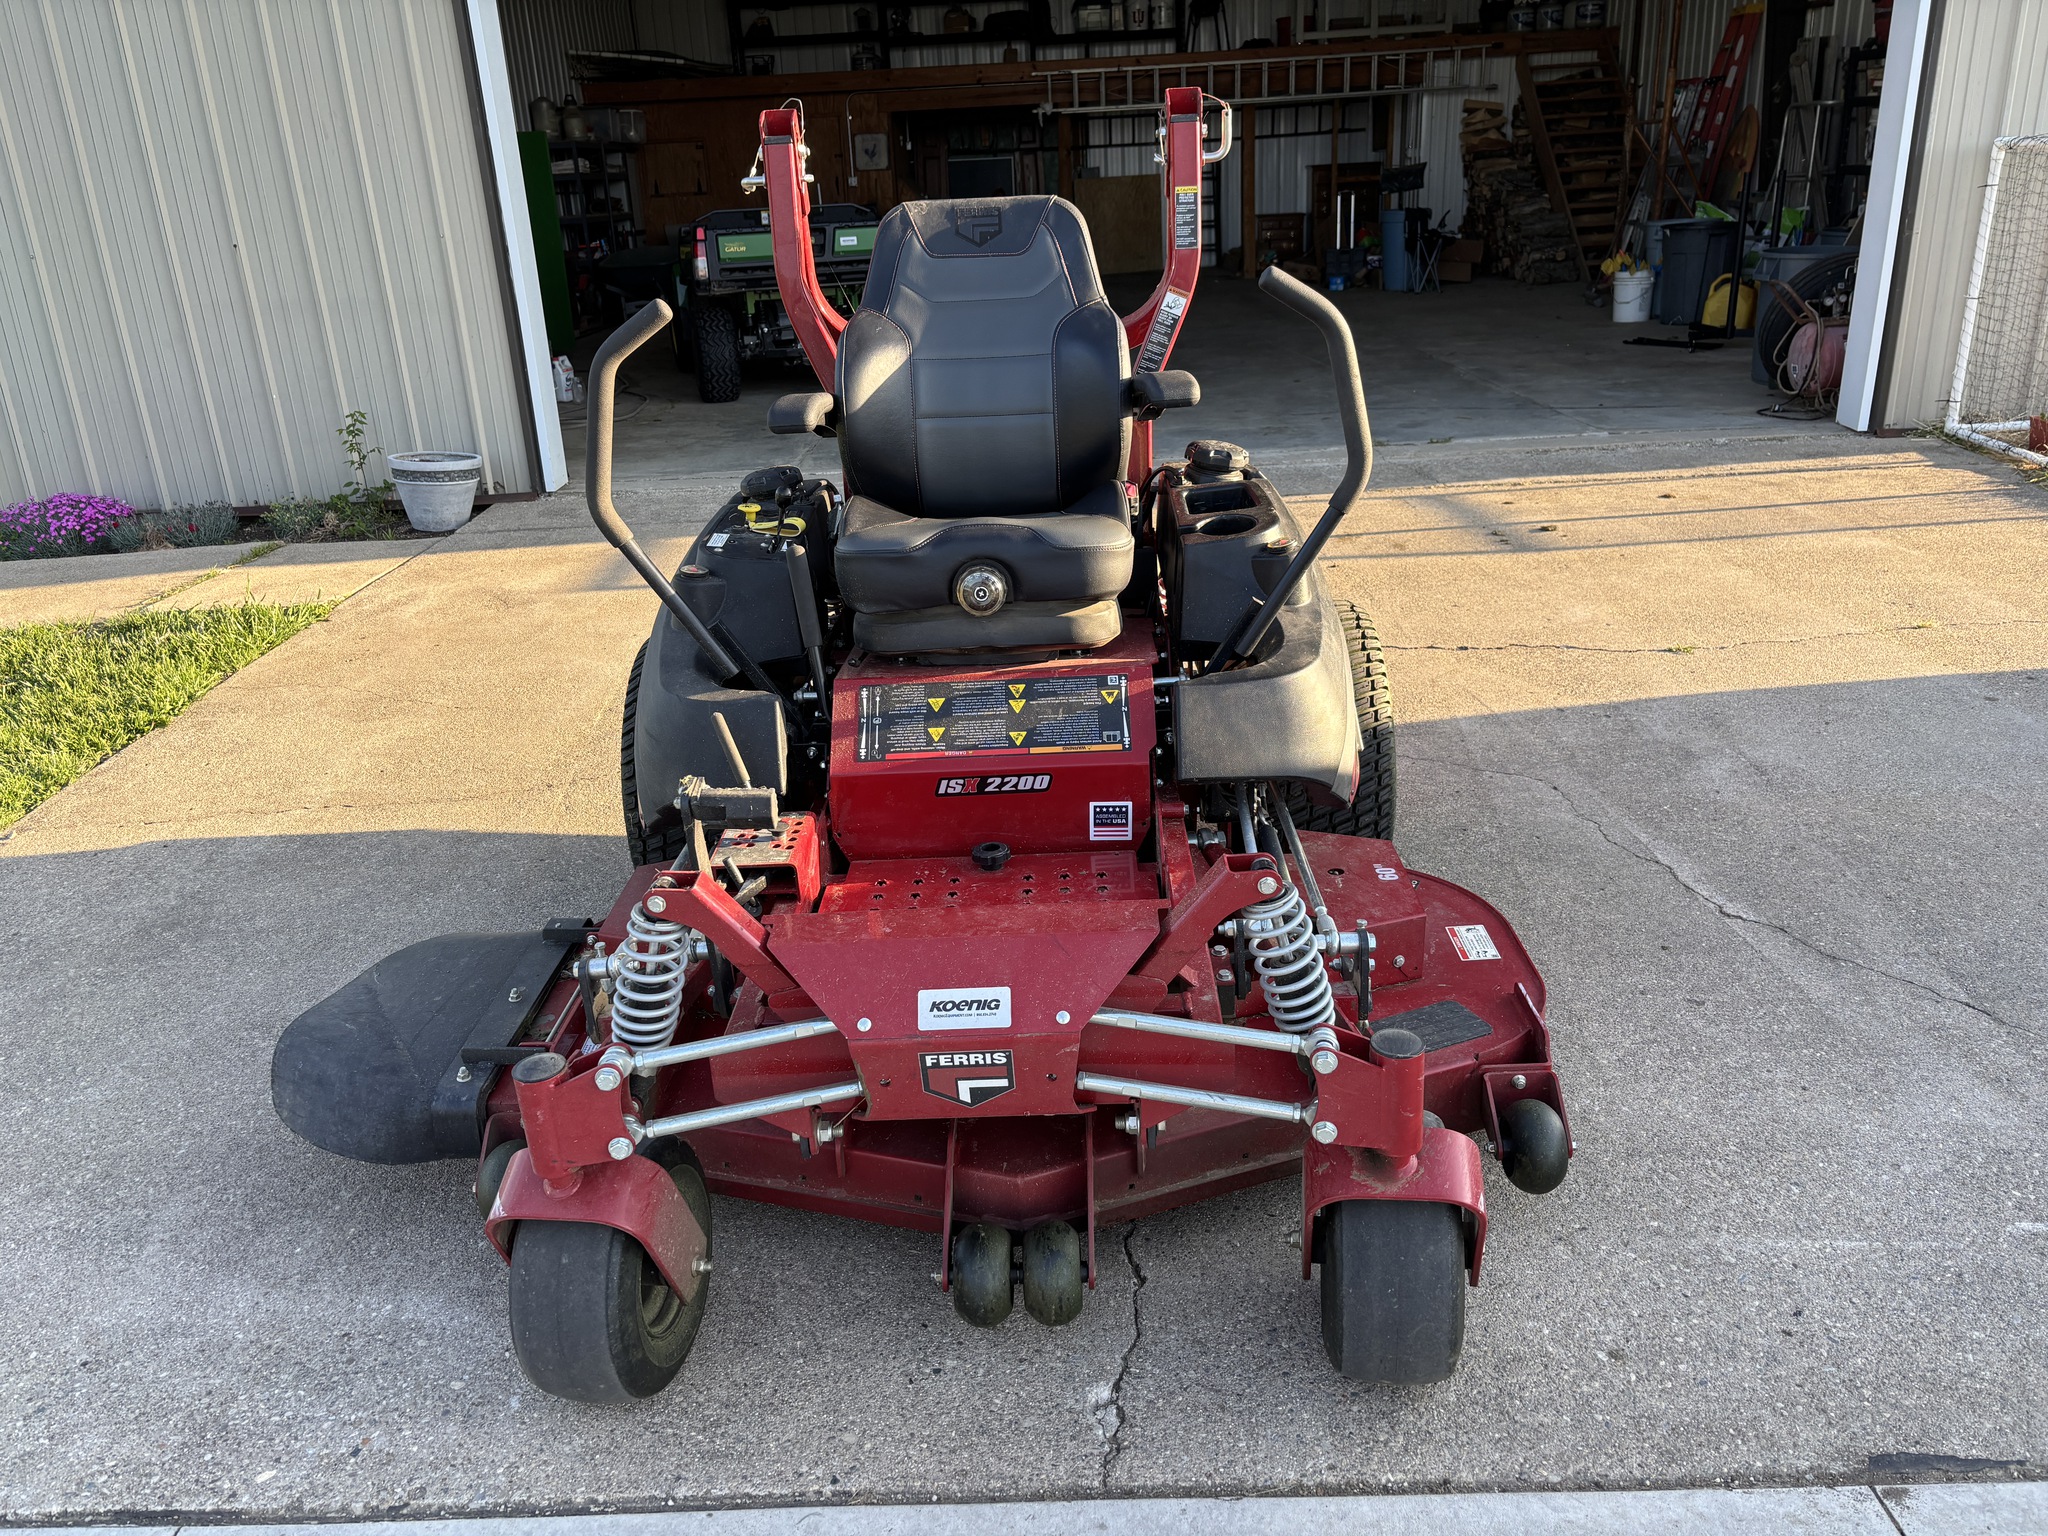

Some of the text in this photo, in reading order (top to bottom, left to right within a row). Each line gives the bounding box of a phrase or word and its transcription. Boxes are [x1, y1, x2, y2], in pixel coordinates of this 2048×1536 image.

[938, 775, 1051, 794] ISX 2200
[925, 1052, 1008, 1067] FERRIS
